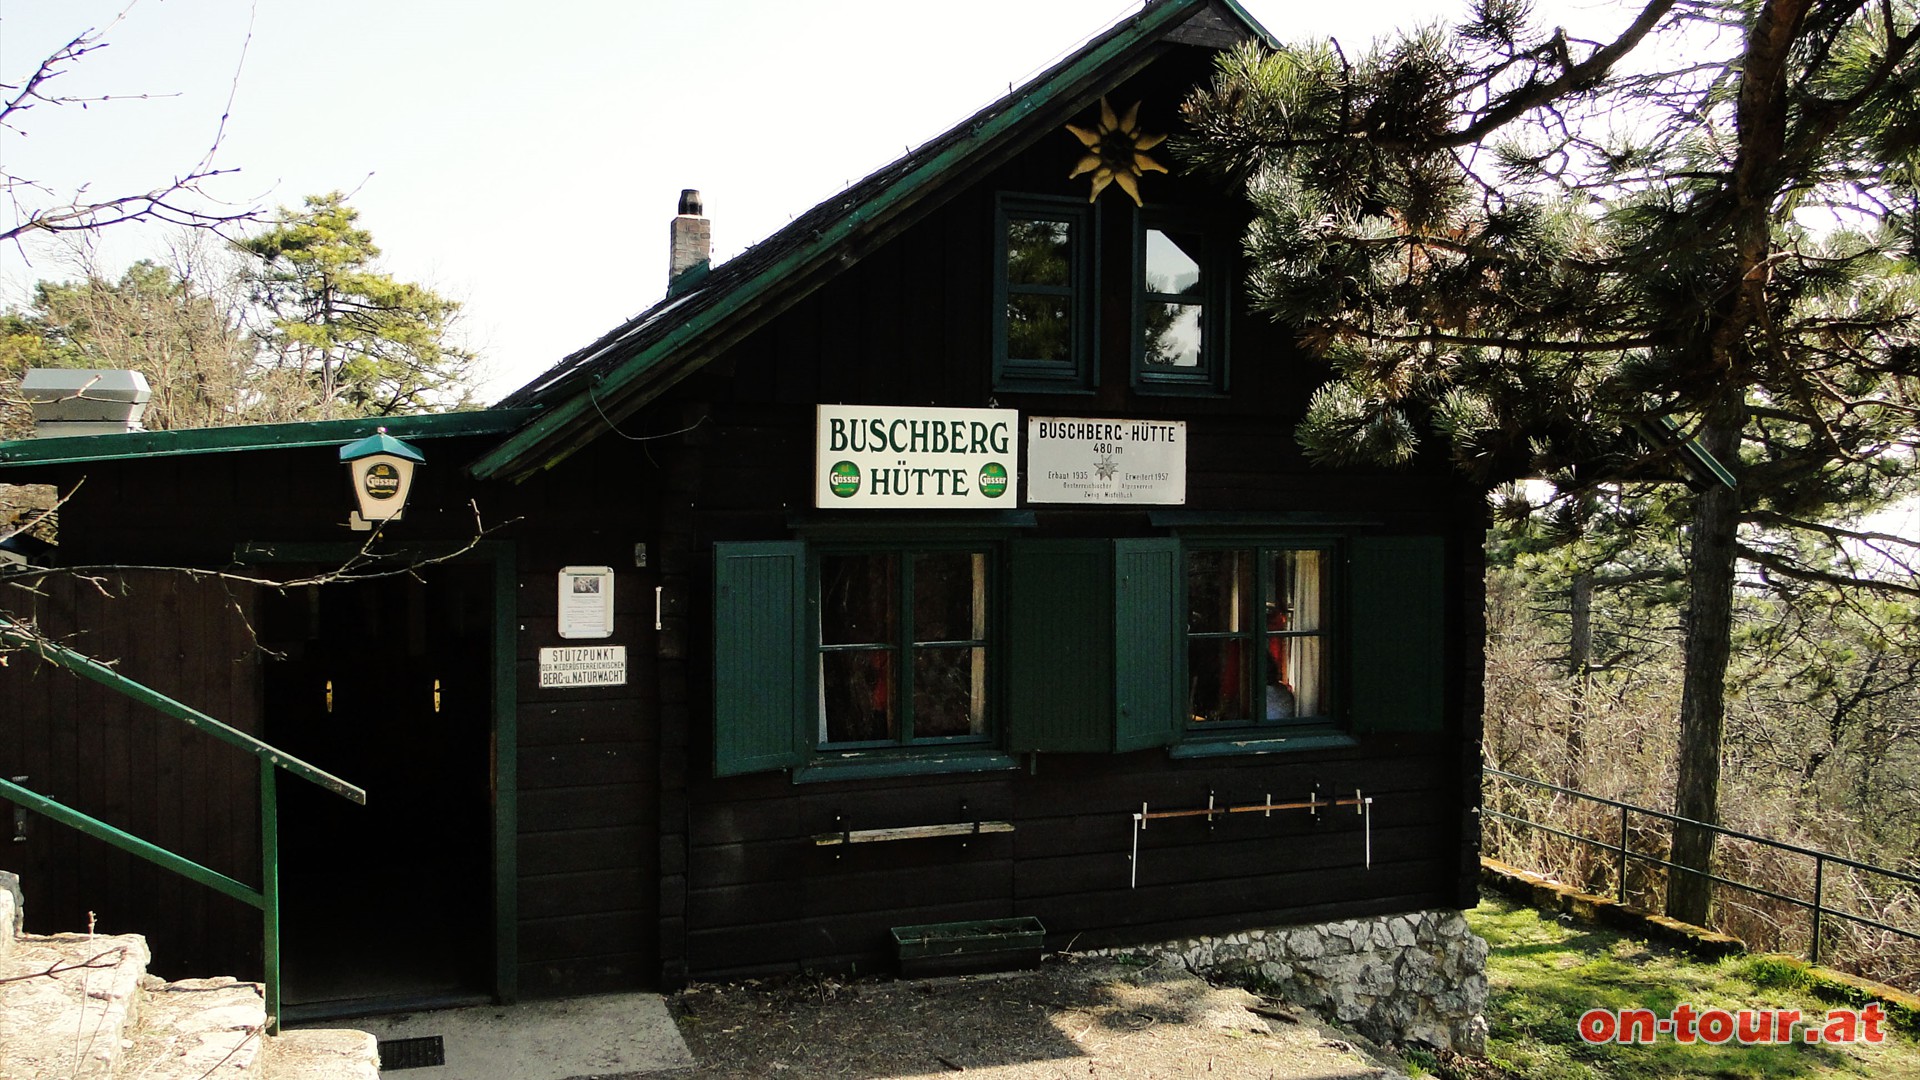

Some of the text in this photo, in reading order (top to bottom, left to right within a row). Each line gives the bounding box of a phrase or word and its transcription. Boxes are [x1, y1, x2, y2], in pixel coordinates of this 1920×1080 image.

[829, 418, 1009, 455] BUSCHBERG
[1093, 443, 1123, 454] 480 m
[366, 474, 399, 488] Gösser
[830, 472, 860, 485] Gösser
[870, 460, 970, 497] HÜTTE
[979, 473, 1007, 486] Gösser
[1048, 471, 1088, 480] Erbaut 1935
[1155, 473, 1169, 481] 1957
